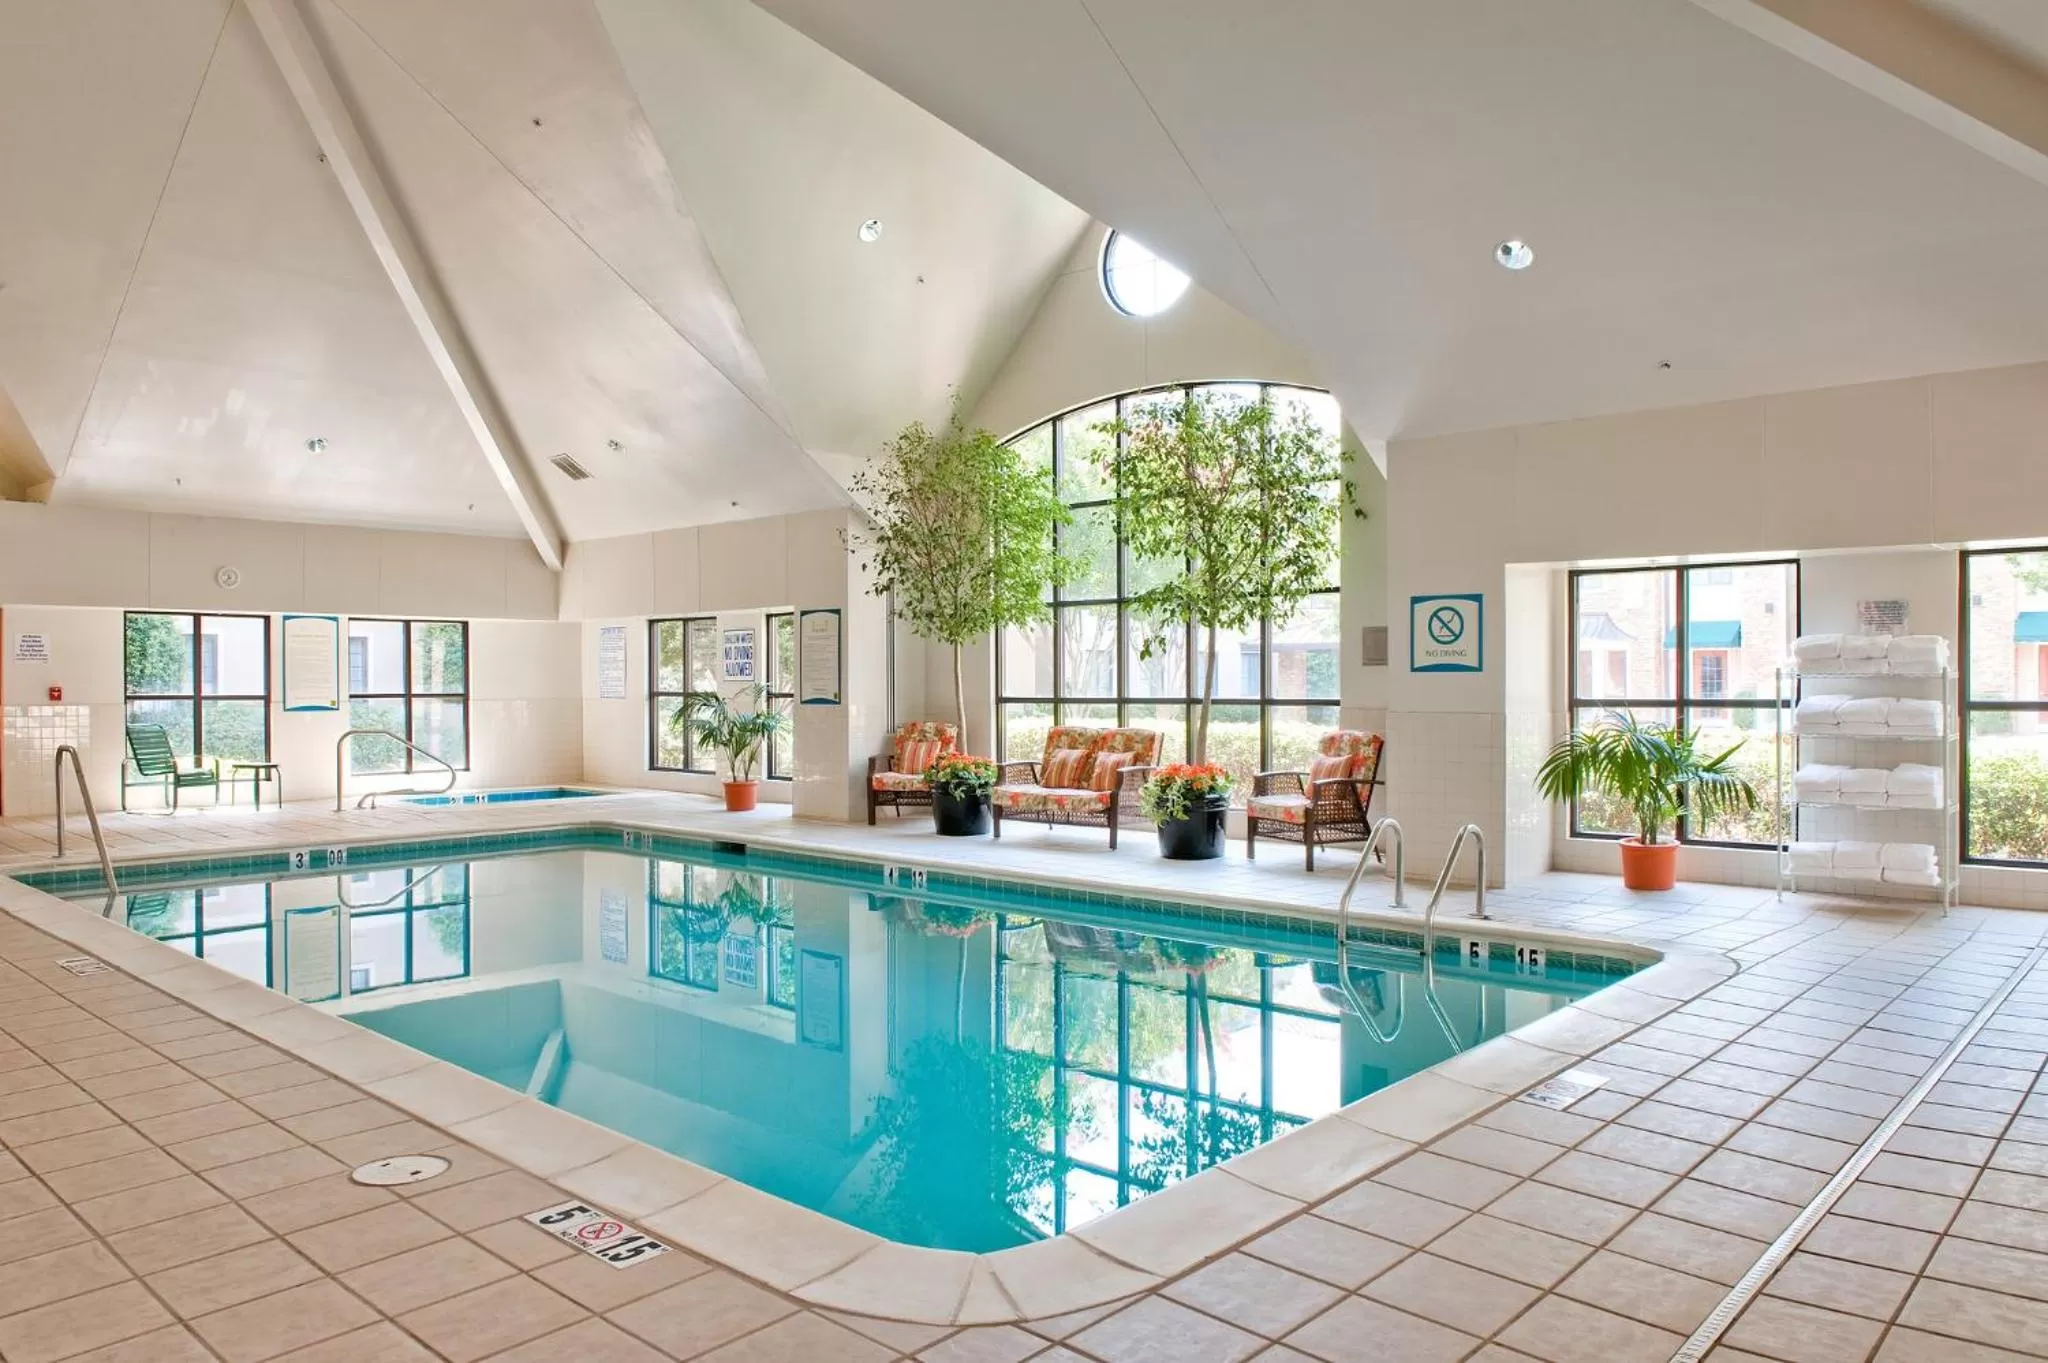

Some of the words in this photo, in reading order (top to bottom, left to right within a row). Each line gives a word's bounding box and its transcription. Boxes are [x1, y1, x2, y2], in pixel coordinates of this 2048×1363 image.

[725, 647, 732, 660] NO
[734, 646, 752, 660] DIVING
[726, 662, 752, 676] ALLOWED
[296, 853, 304, 869] 3
[1470, 942, 1479, 958] 5
[539, 1206, 592, 1224] 5
[596, 1236, 662, 1262] 1.5
